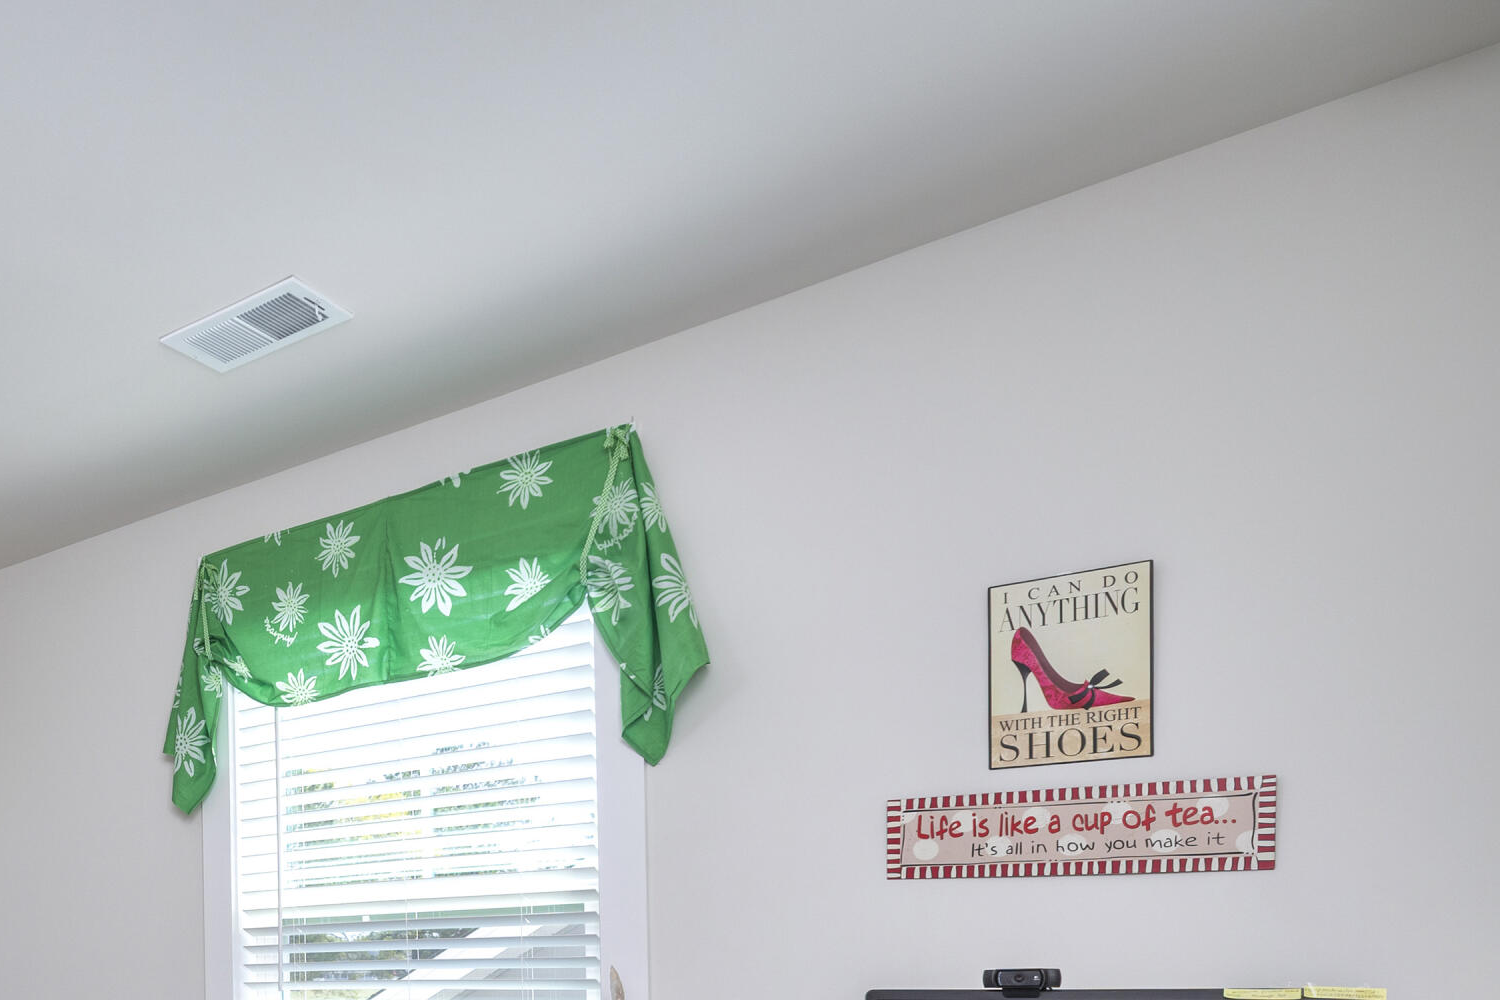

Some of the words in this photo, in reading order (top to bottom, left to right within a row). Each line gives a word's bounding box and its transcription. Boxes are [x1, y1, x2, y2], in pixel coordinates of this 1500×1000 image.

[1003, 592, 1009, 604] I
[1028, 580, 1082, 600] CAN
[1103, 571, 1139, 588] DO
[999, 587, 1140, 632] ANYTHING
[999, 717, 1042, 731] WITH
[1047, 713, 1081, 727] THE
[1086, 706, 1142, 724] RIGHT
[999, 722, 1142, 762] SHOES
[916, 814, 964, 840] Life
[972, 812, 990, 838] is
[999, 811, 1039, 837] like
[1048, 814, 1061, 834] a
[1072, 811, 1112, 835] cup
[1122, 804, 1156, 831] of
[1165, 802, 1237, 828] tea...
[971, 842, 998, 857] It's
[1006, 842, 1023, 855] all
[1031, 841, 1047, 854] in
[1056, 839, 1095, 853] how
[1105, 838, 1137, 853] you
[1145, 835, 1198, 849] make
[1207, 831, 1225, 846] it
